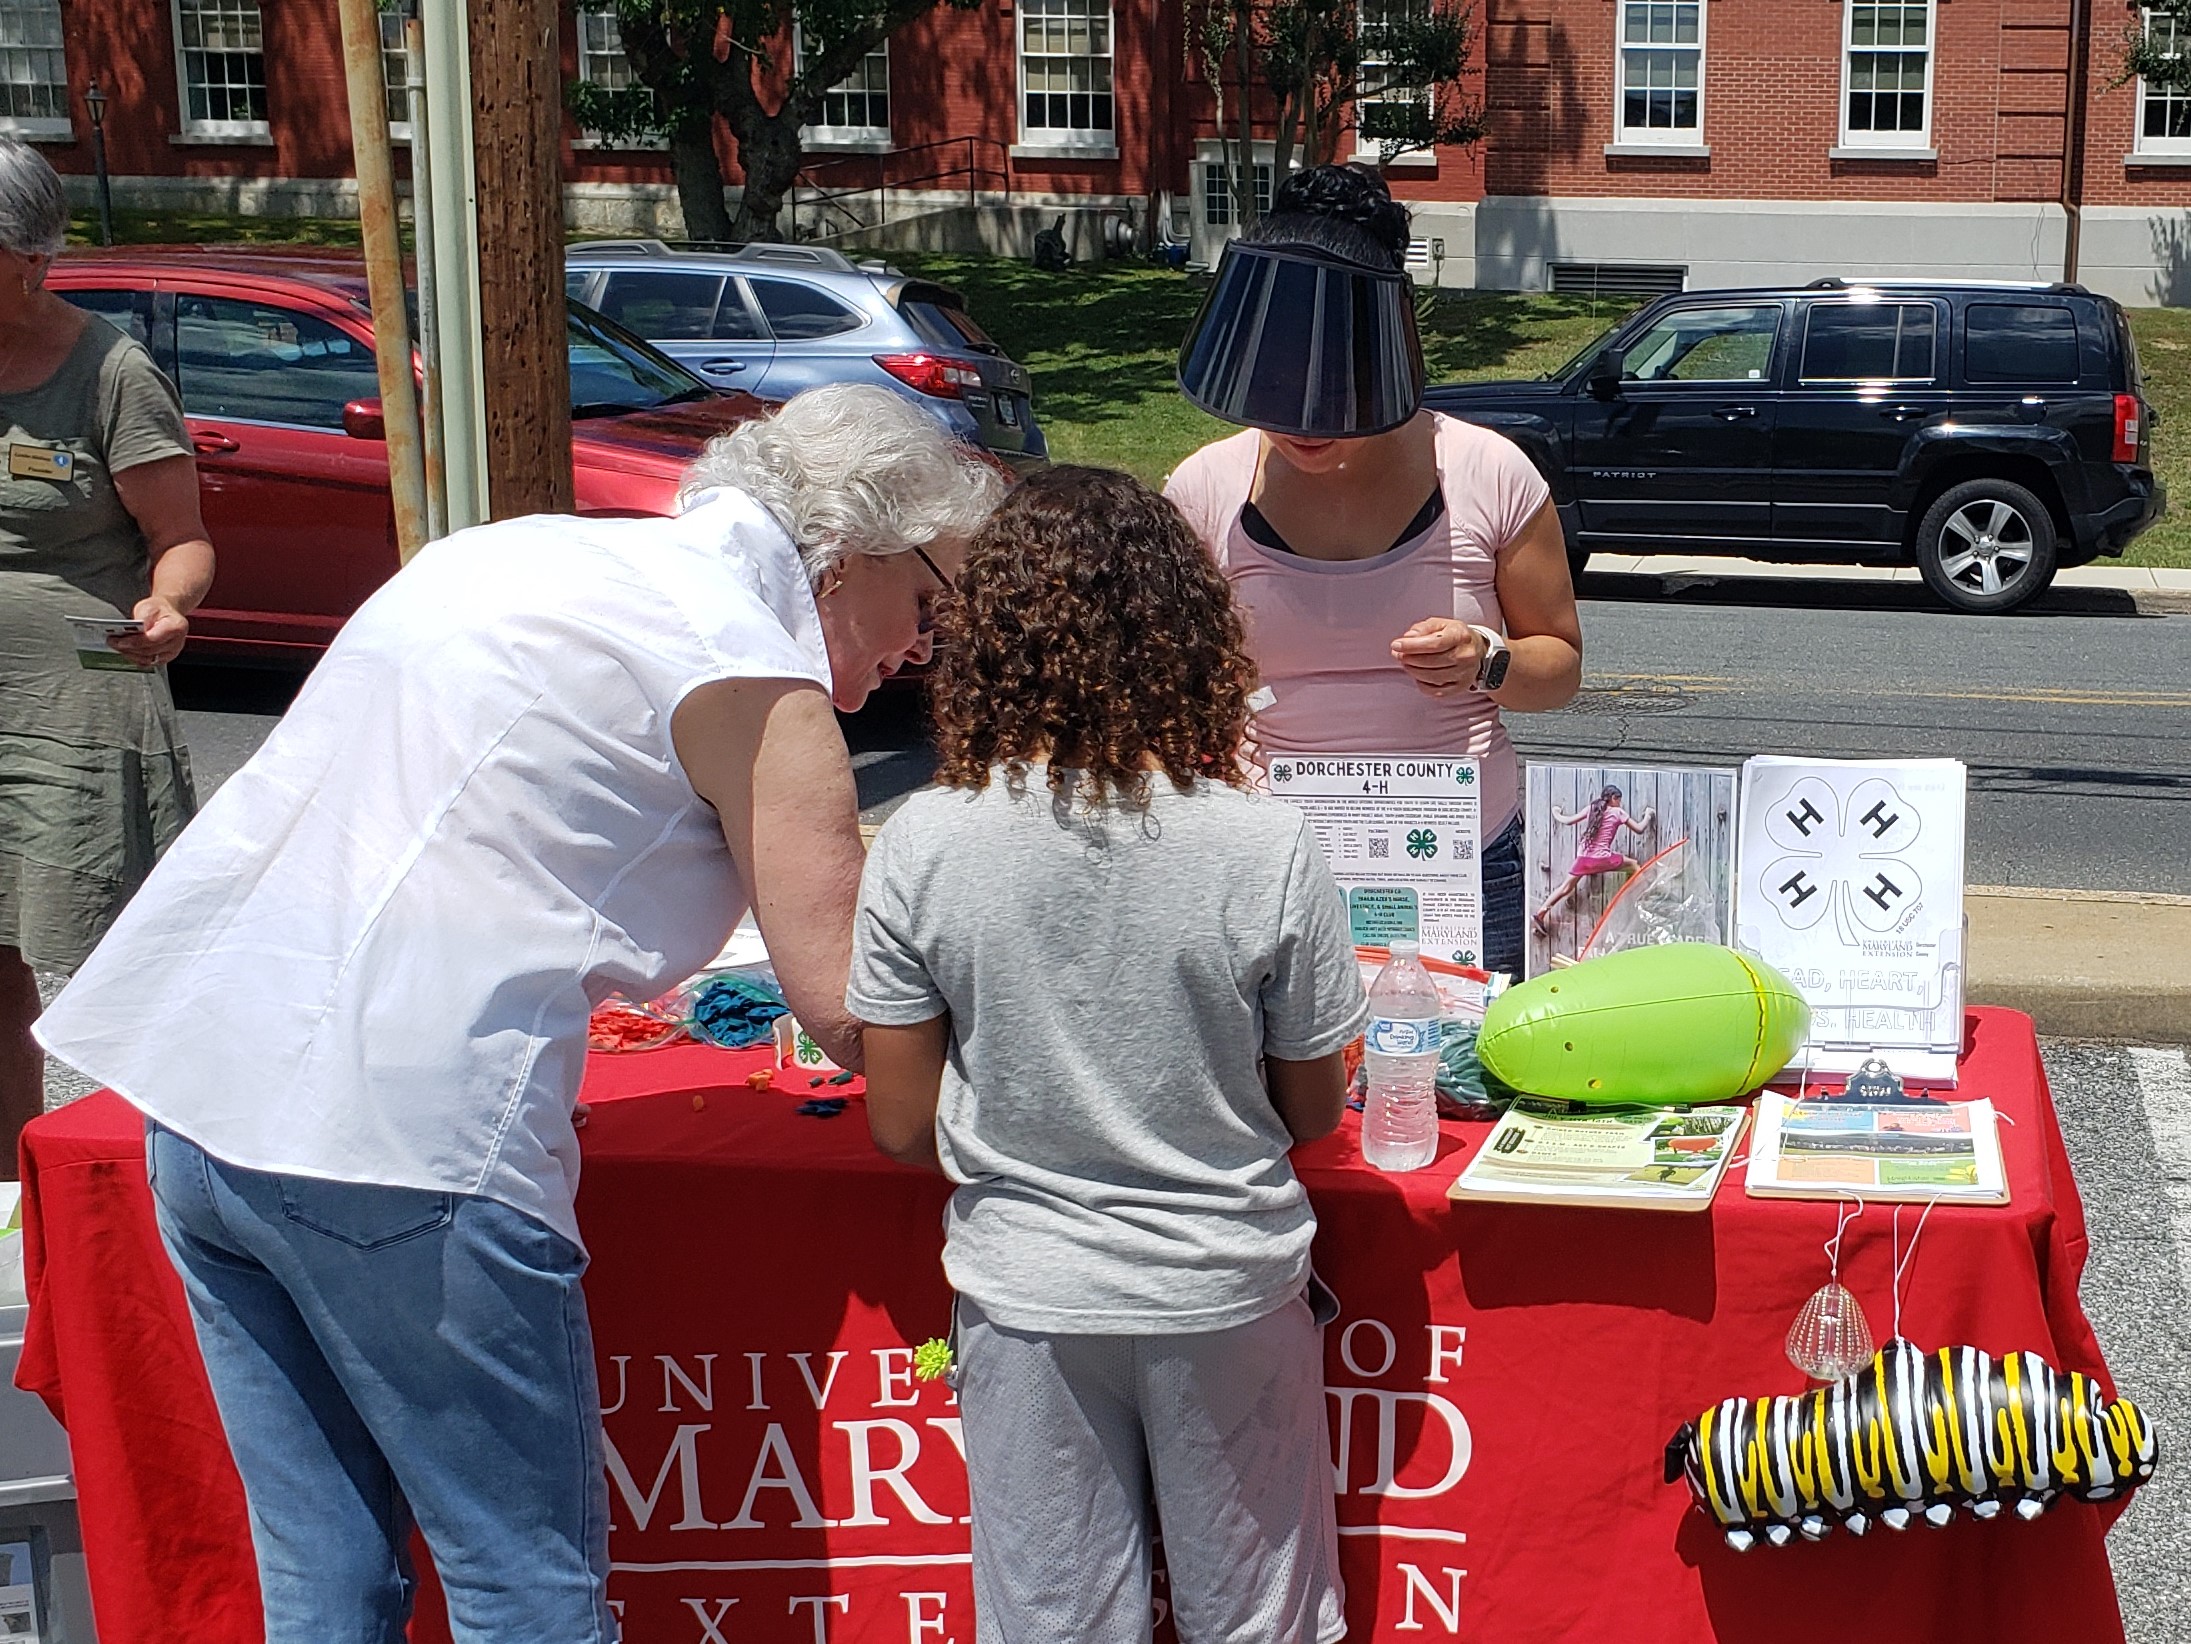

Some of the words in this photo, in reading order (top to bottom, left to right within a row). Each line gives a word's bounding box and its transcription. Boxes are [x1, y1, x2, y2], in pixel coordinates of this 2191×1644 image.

[1593, 471, 1656, 479] PATRIOT
[1296, 762, 1392, 777] DORCHESTER
[1397, 763, 1453, 778] COUNTY
[1362, 780, 1389, 795] 4-H
[1786, 797, 1825, 837] H
[1859, 799, 1900, 839] H
[1778, 870, 1818, 909] H
[1862, 872, 1903, 911] H
[1422, 930, 1478, 938] MARYLAND
[1839, 970, 1924, 995] HEART,
[1341, 1319, 1467, 1383] OF
